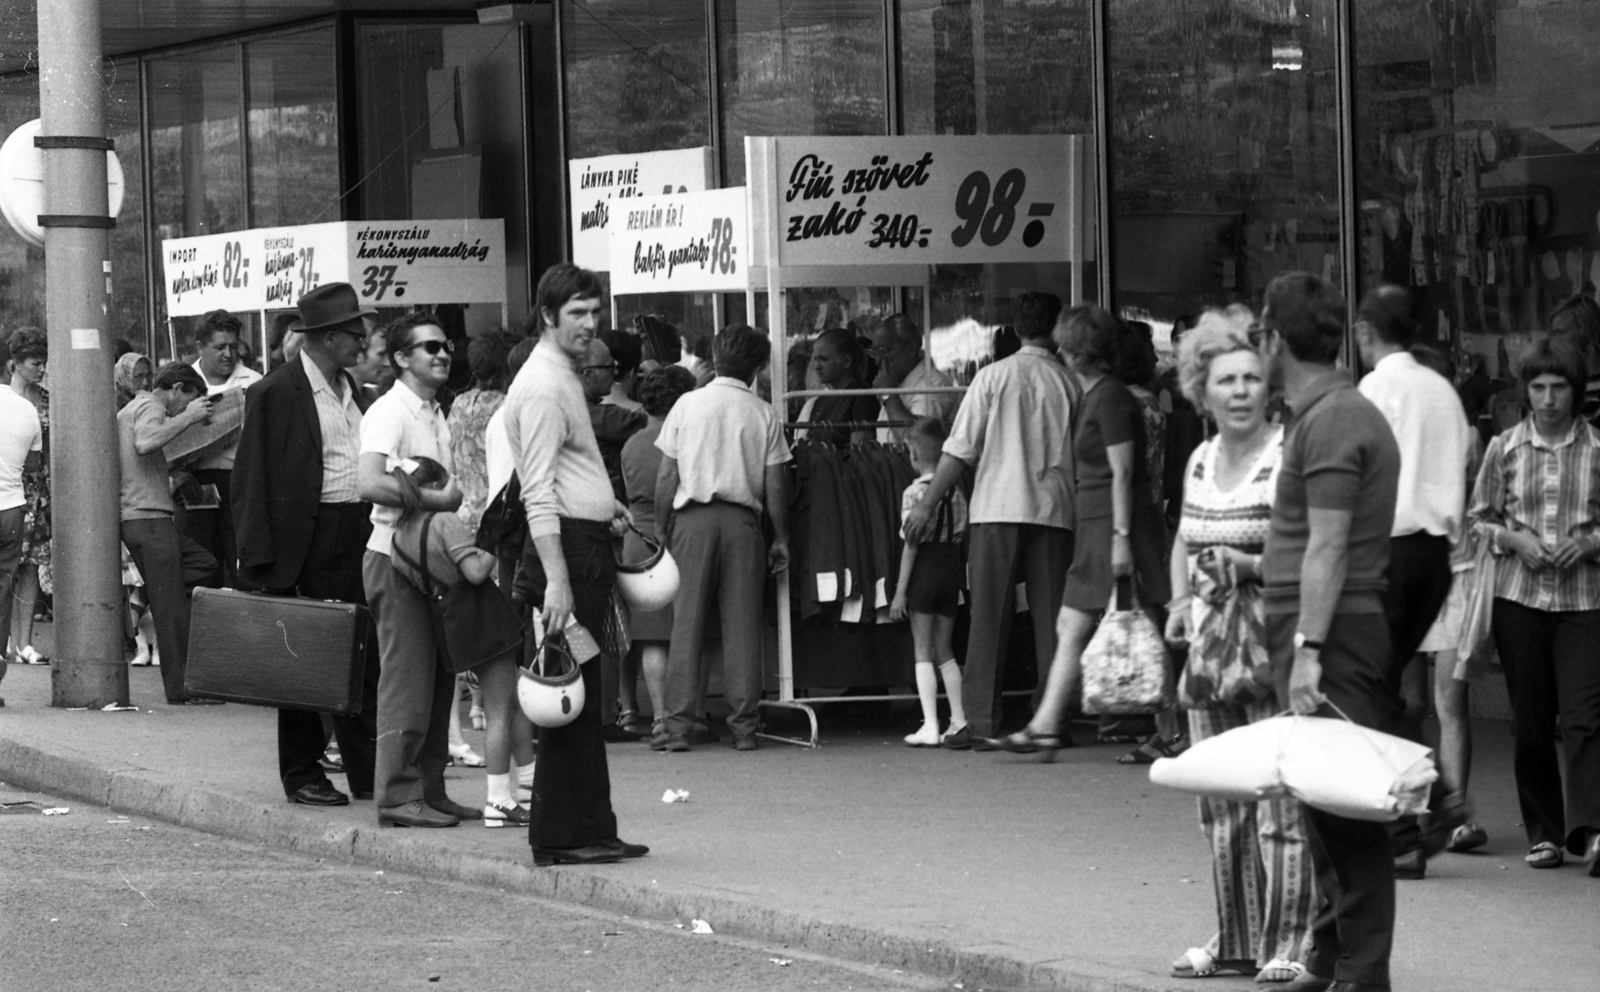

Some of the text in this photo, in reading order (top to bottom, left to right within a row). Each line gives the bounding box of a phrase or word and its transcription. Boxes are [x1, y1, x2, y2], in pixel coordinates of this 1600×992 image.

[581, 161, 639, 190] LÁNYKA PIKÉ
[786, 151, 934, 203] Fiú szövet
[627, 203, 663, 231] REKLÁM
[785, 195, 867, 242] zakó
[356, 225, 430, 241] VÉKONYSZÁLU
[168, 247, 197, 264] IMPORT
[356, 238, 490, 265] harisnyanadrág
[633, 239, 666, 279] bakfis
